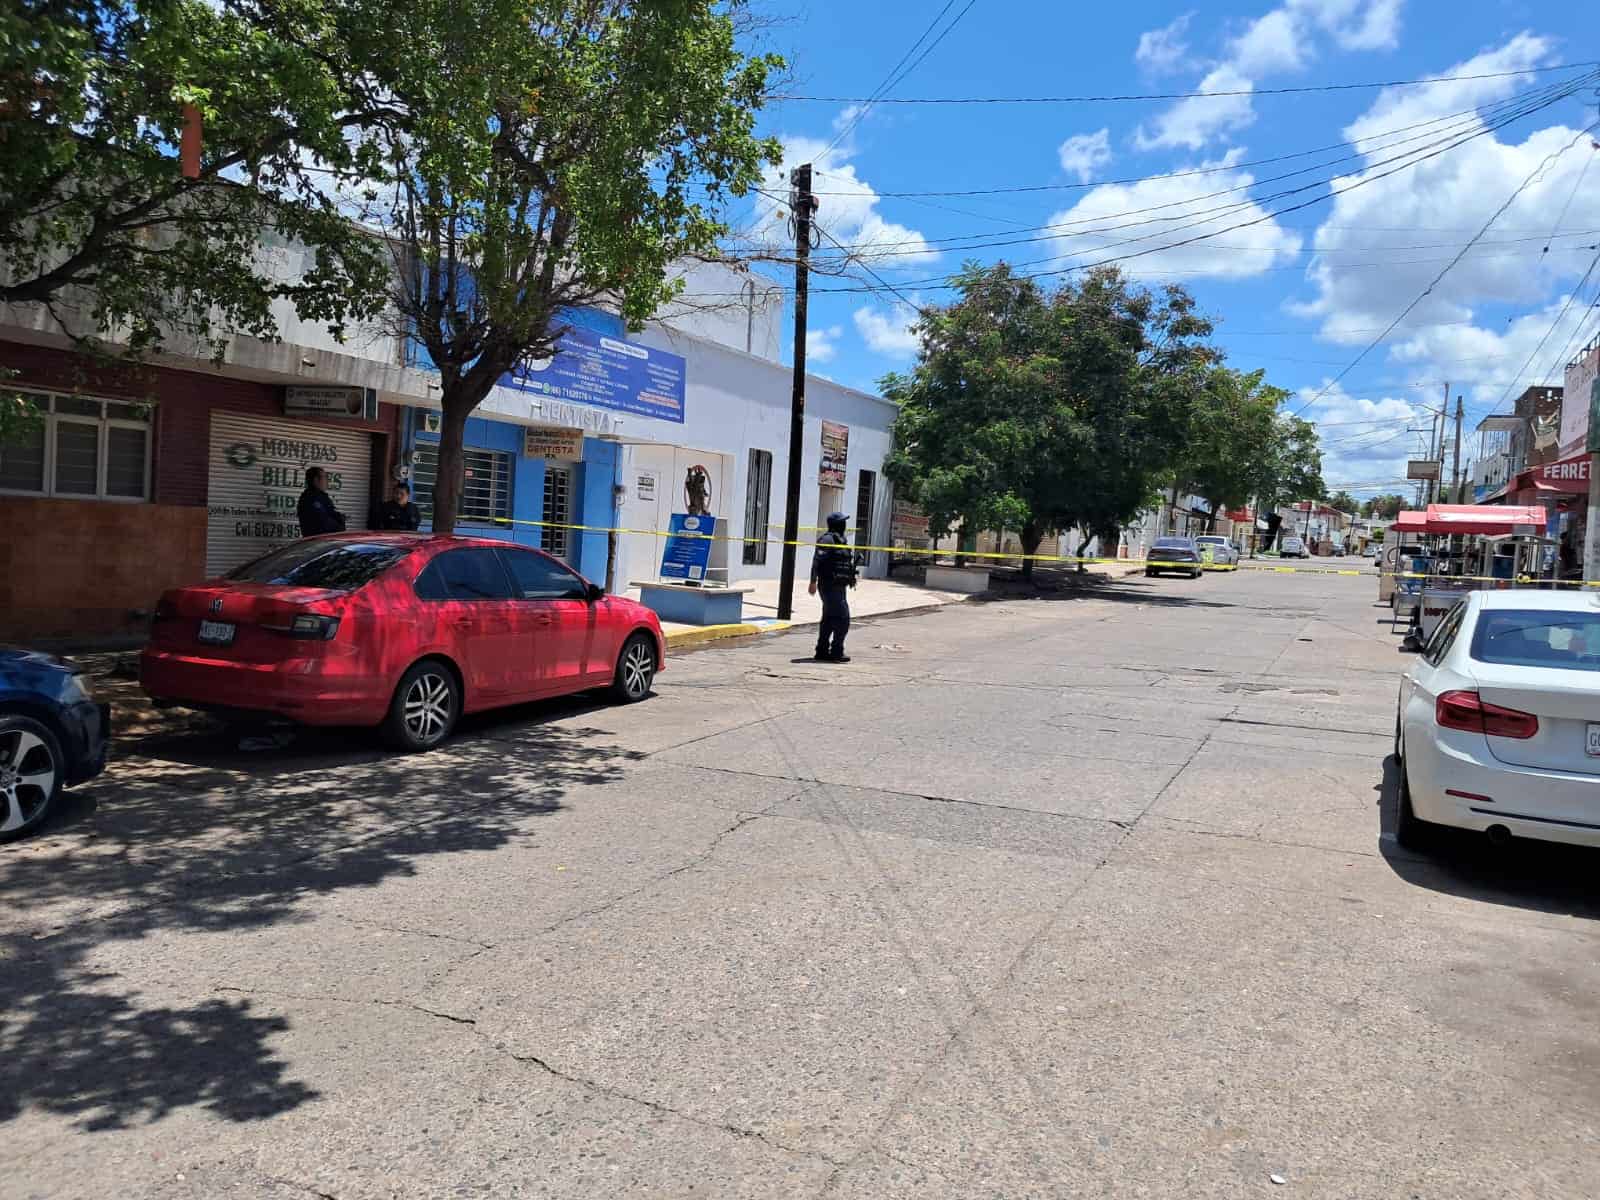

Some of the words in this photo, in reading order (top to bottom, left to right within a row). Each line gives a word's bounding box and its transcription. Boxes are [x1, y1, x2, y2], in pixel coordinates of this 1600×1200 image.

[541, 399, 609, 430] DENTISTA
[263, 438, 337, 462] MONEDAS
[263, 465, 343, 490] BILLES
